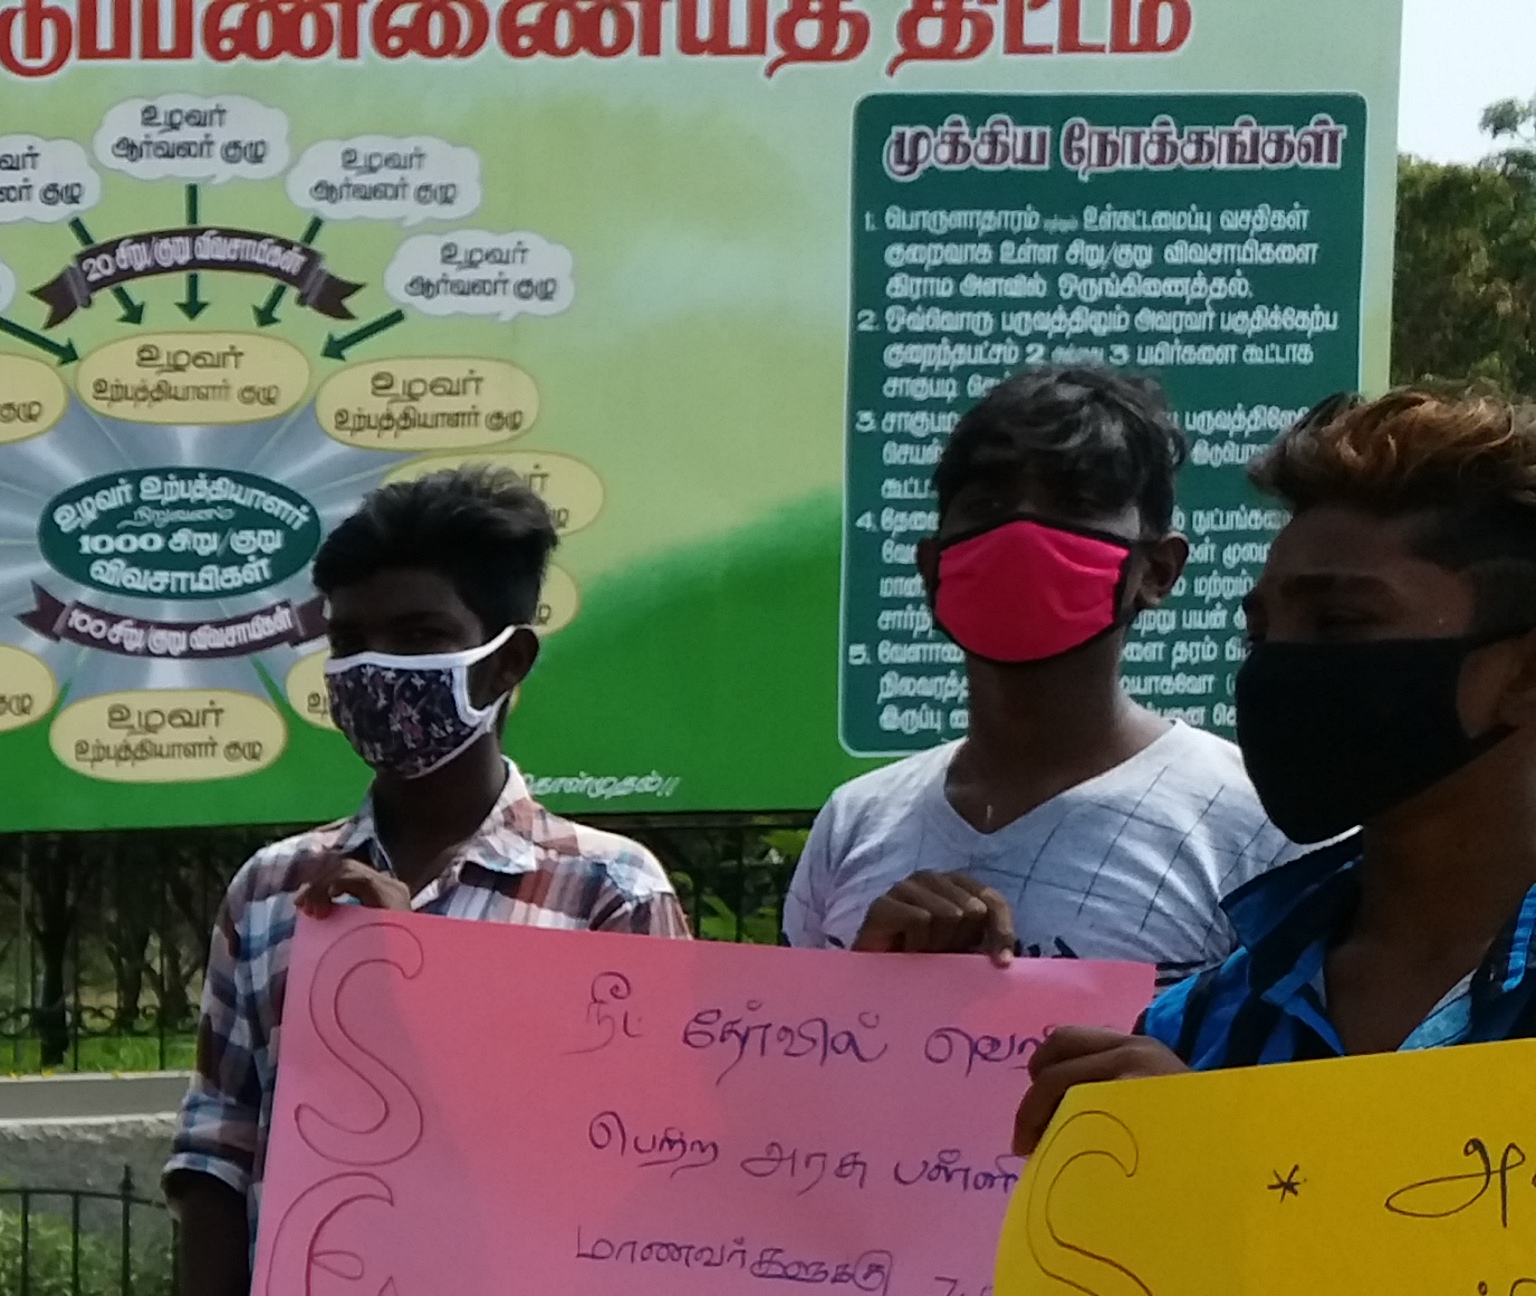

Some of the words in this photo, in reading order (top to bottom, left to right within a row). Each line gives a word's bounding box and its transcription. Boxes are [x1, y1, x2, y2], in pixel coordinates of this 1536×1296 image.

[141, 103, 227, 134] உழவர்
[112, 134, 215, 163] ஆர்வலர்
[220, 137, 269, 165] குழு
[340, 146, 426, 176] உழவர்
[883, 112, 1053, 182] முக்கிய
[1060, 112, 1347, 183] நோக்கங்கள்
[39, 179, 85, 207] குழு
[309, 176, 409, 204] ஆர்வலர்
[412, 179, 458, 206] குழு
[81, 253, 116, 282] 20
[440, 239, 530, 272] உழவர்
[404, 271, 511, 300] ஆர்வலர்
[513, 274, 558, 301] குழு
[136, 343, 245, 376] உழவர்
[1025, 343, 1047, 364] 2
[1109, 343, 1131, 366] 3
[92, 377, 232, 408] உற்பத்தியாளர்
[236, 383, 280, 407] குழு
[370, 369, 485, 405] உழவர்
[334, 404, 481, 439] உற்பத்தியாளர்
[484, 408, 524, 432] குழு
[52, 477, 133, 534] உழவர்
[139, 472, 311, 531] உற்பத்தியாளர்
[78, 532, 164, 555] 1000
[89, 554, 273, 594] விவசாயிகள்
[67, 608, 107, 640] 100
[107, 701, 225, 738] உழவர்
[74, 736, 218, 768] உற்பத்தியாளர்
[222, 740, 264, 761] குழு
